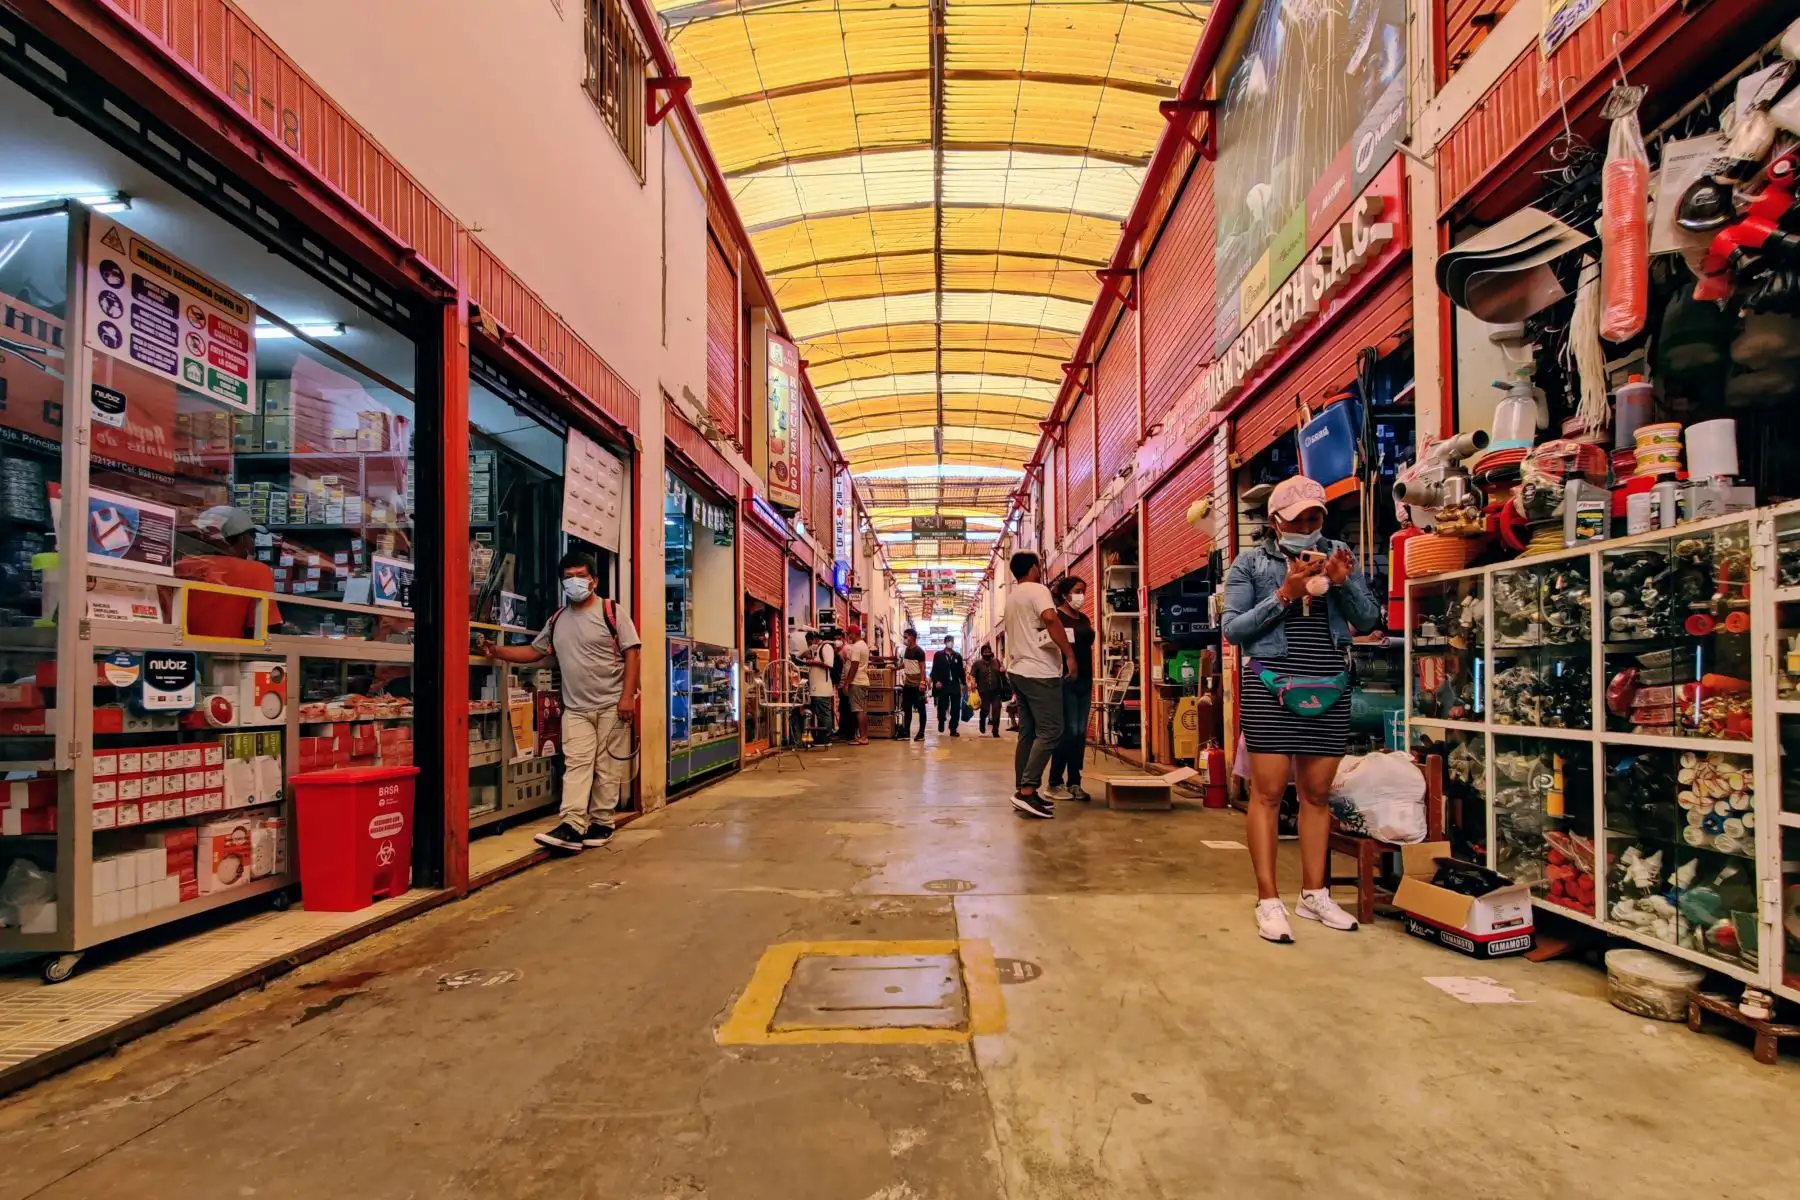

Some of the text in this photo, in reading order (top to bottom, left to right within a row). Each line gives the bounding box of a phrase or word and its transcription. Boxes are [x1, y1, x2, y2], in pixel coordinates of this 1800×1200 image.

[1375, 102, 1404, 145] Miller
[1236, 265, 1306, 380] SOLTECH
[1312, 196, 1393, 301] S.A.C.
[22, 433, 62, 452] Principa
[788, 375, 798, 492] REPUESTOS
[149, 658, 188, 671] niubiz
[378, 785, 399, 797] BASA
[1443, 934, 1473, 951] YAMAMOTO
[1491, 937, 1528, 952] YAMAMOTO
